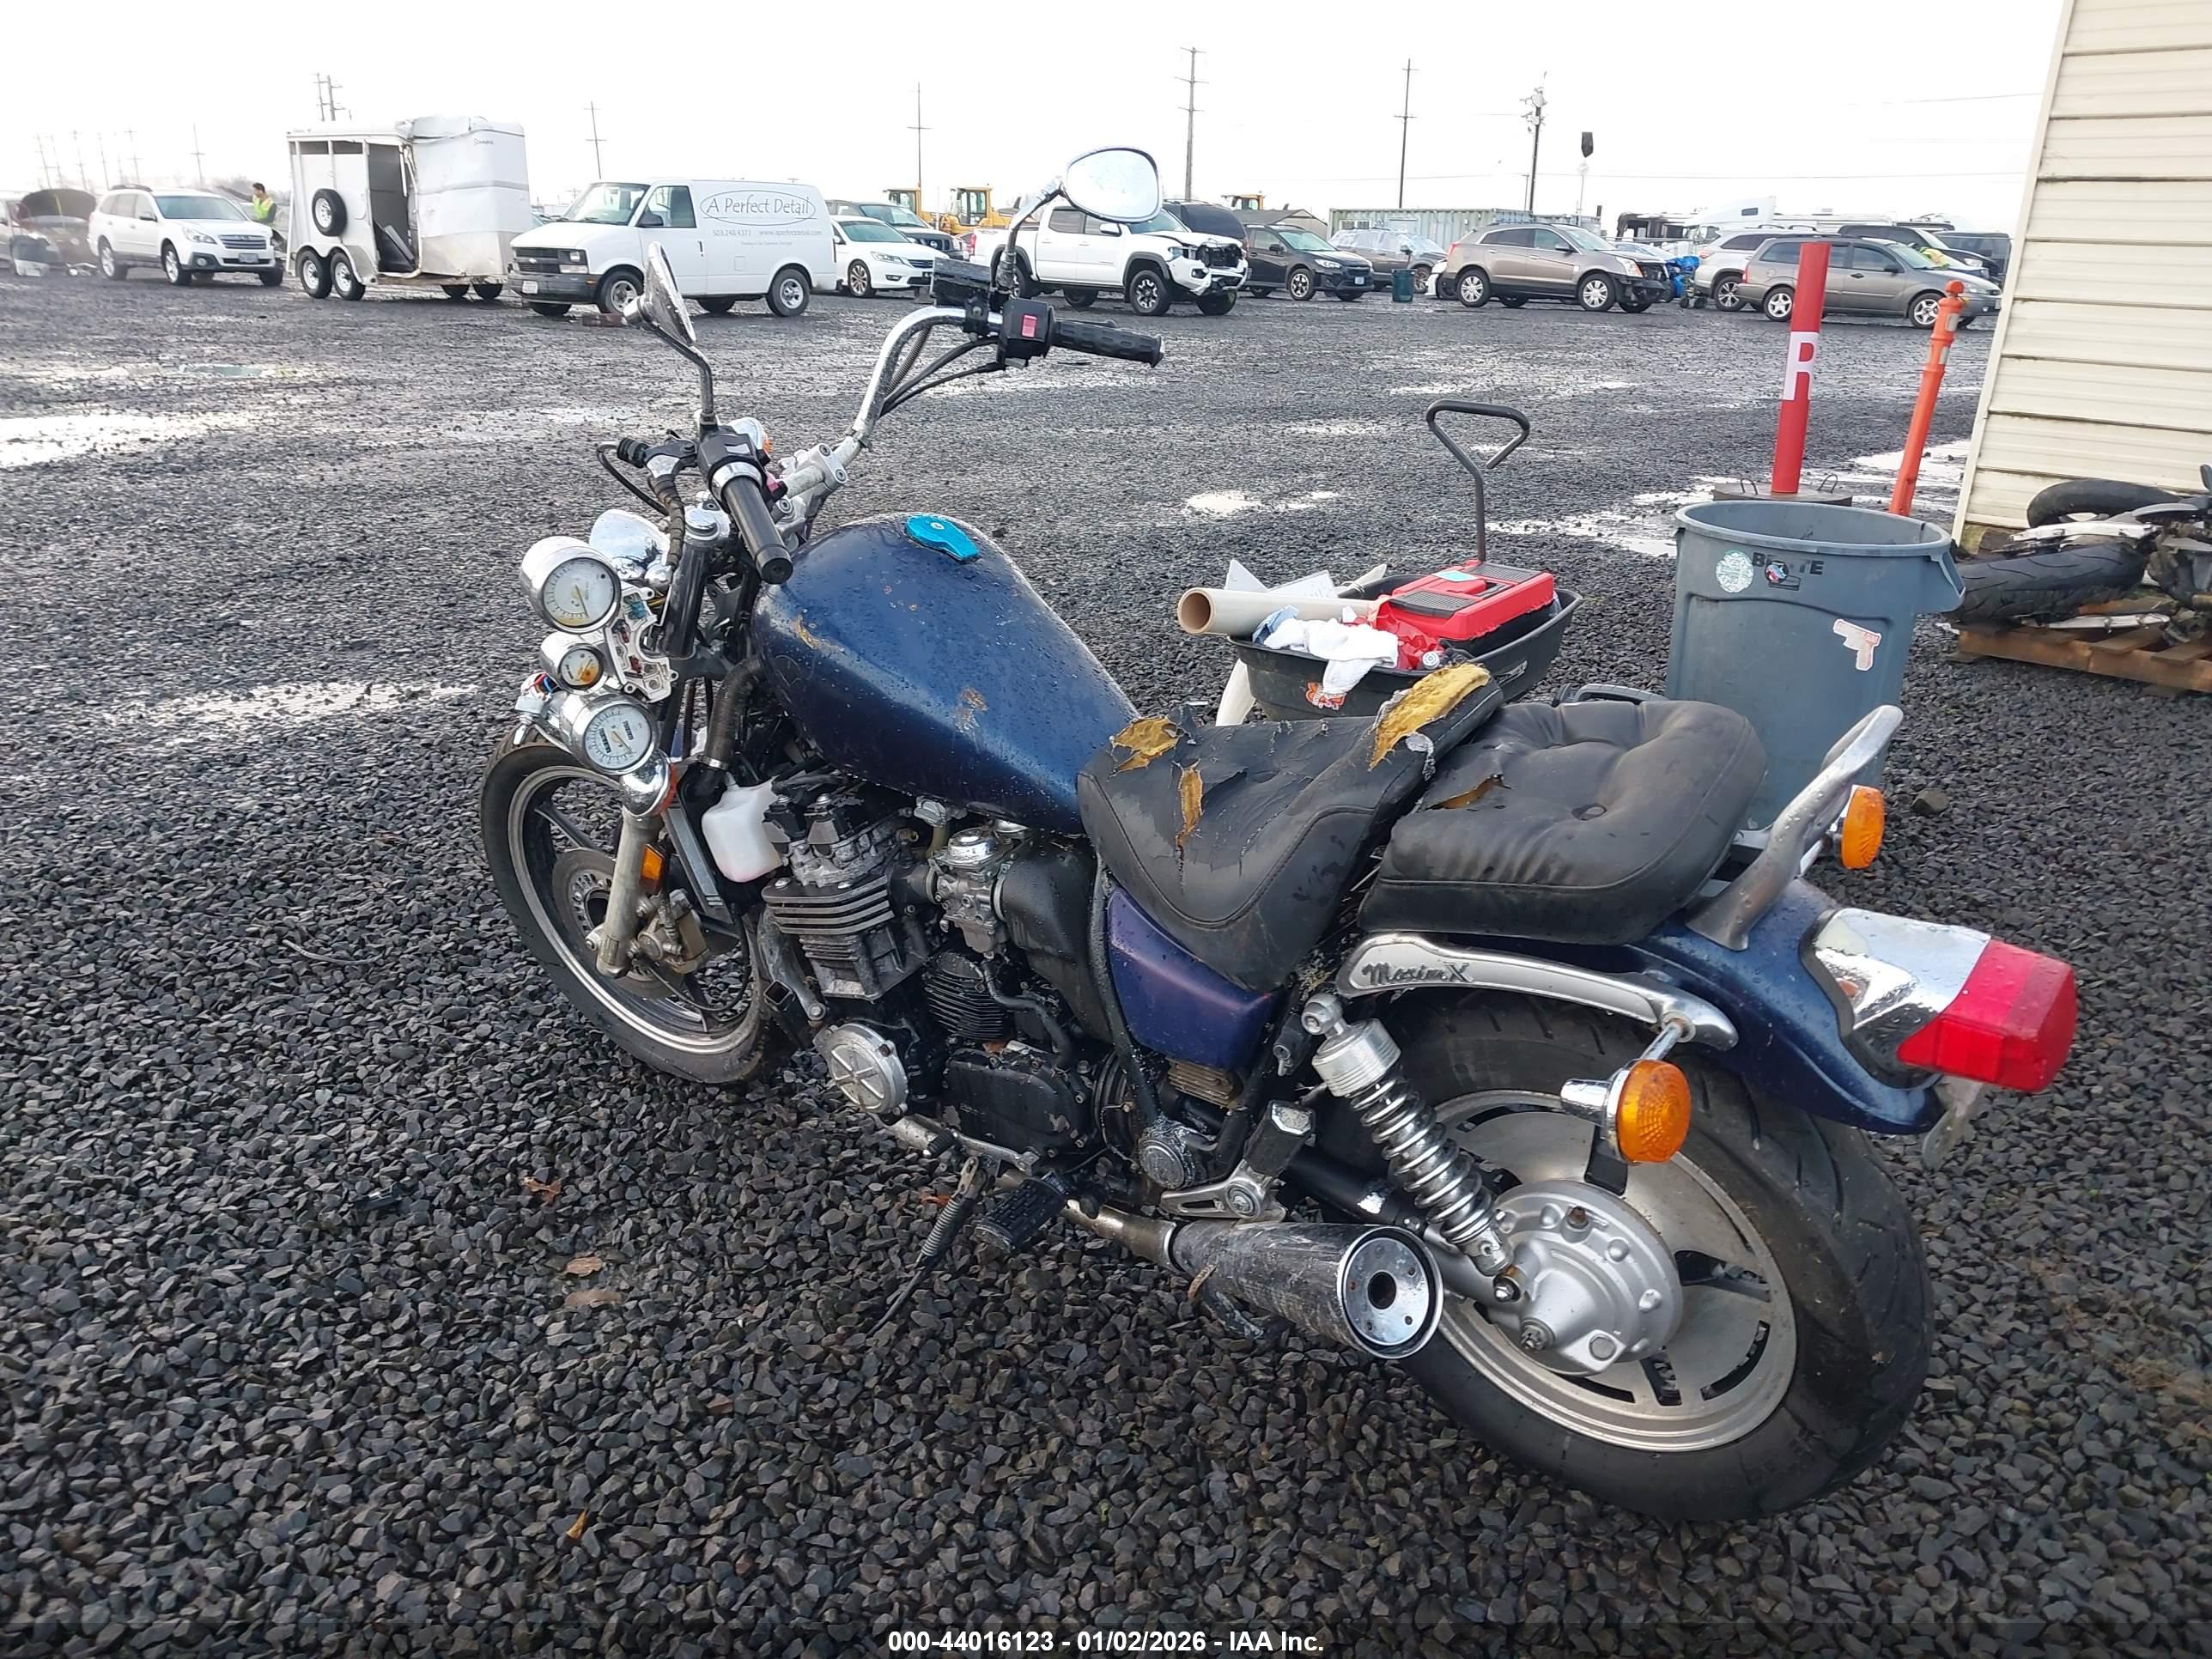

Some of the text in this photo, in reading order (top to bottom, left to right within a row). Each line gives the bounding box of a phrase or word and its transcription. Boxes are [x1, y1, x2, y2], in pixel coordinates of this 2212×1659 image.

[706, 194, 809, 216] A Perfect Detail
